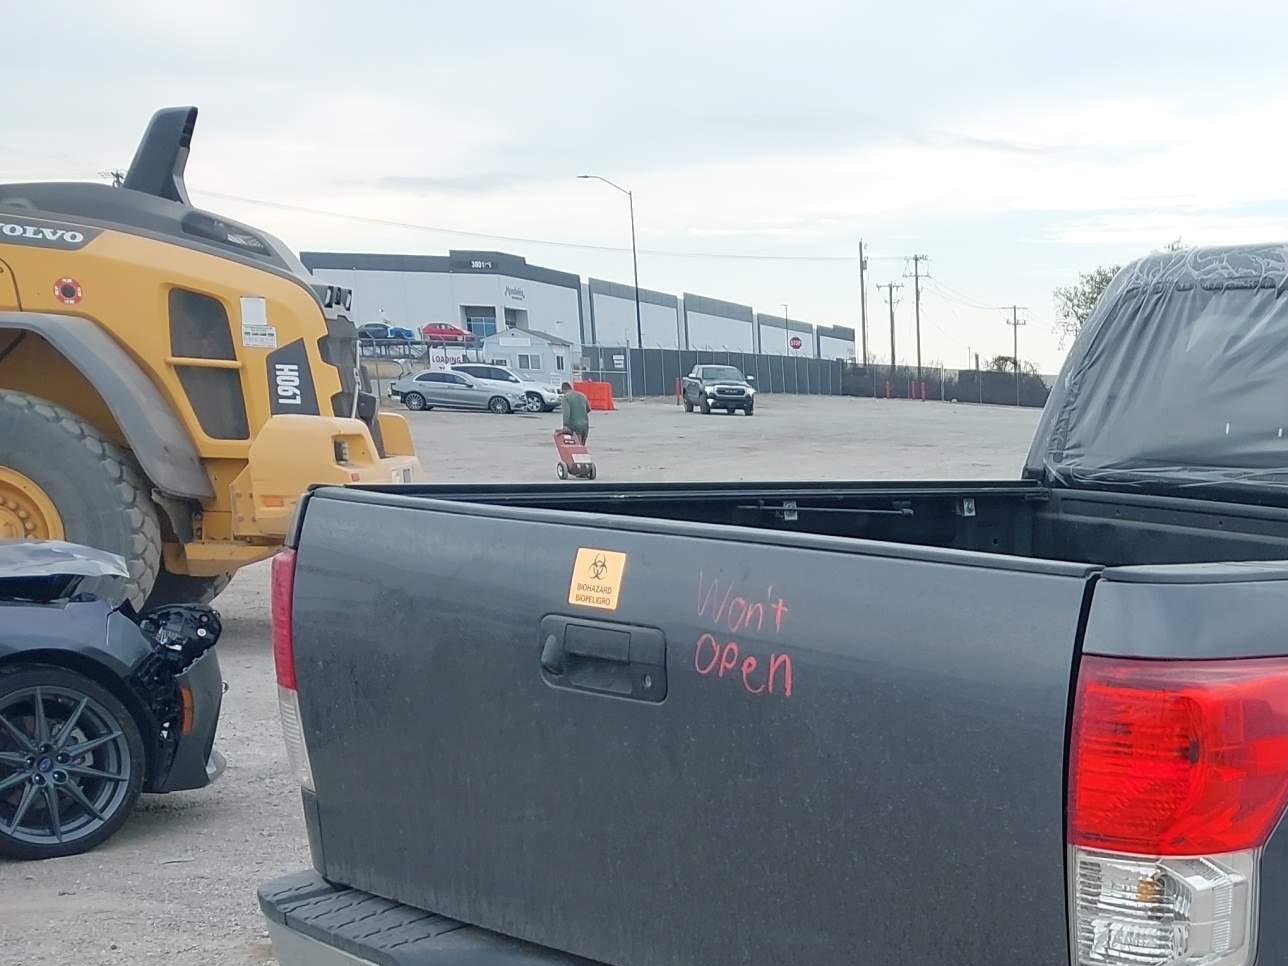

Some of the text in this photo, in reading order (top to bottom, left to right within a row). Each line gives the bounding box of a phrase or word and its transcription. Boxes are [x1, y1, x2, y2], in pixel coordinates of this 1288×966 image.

[0, 223, 84, 242] OLVO
[275, 364, 301, 404] L90H
[577, 583, 612, 594] BIOHAZARD
[575, 594, 611, 606] BIOPELIGRO
[697, 570, 788, 632] Won't
